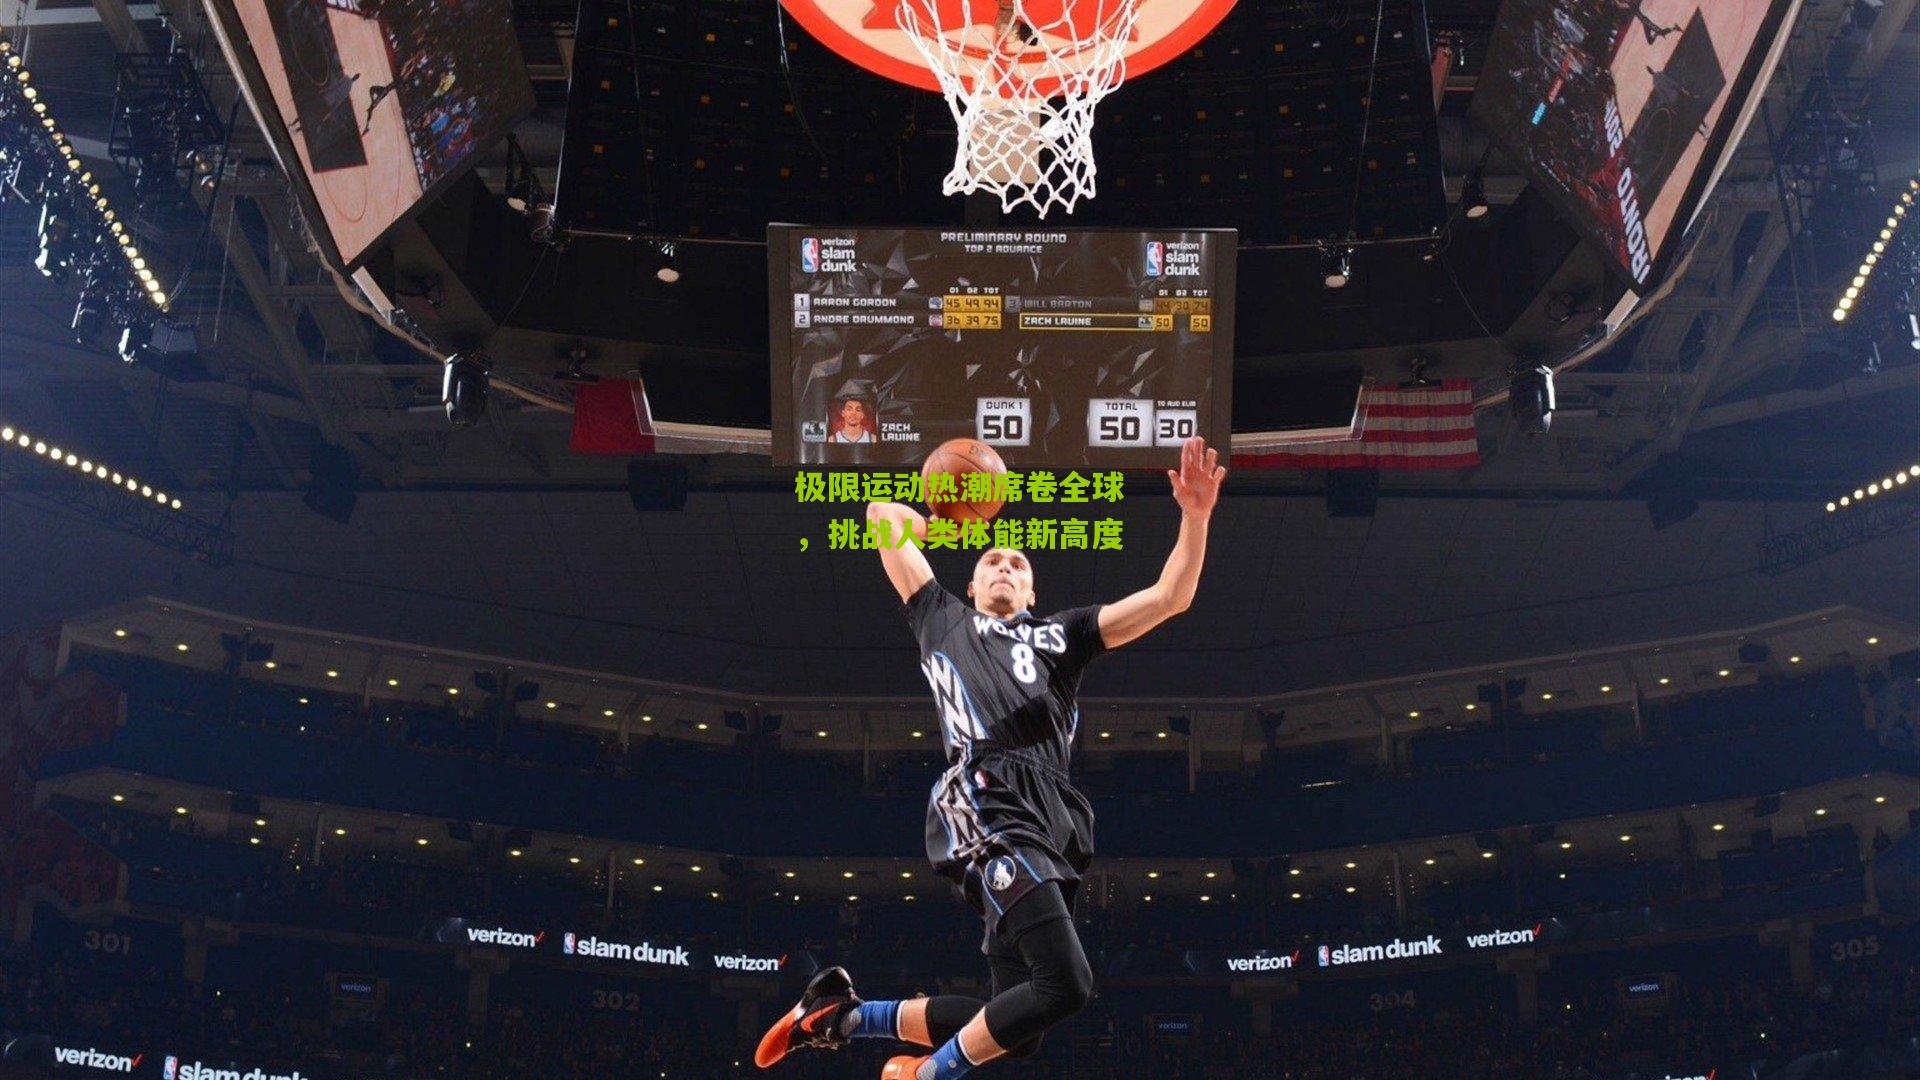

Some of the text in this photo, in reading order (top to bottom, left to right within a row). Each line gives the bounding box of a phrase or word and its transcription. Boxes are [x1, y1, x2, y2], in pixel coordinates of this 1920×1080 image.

[821, 238, 855, 246] verizon
[941, 232, 1067, 243] PRELIMINARY ROUND
[965, 245, 984, 253] TOP
[986, 245, 993, 253] 2
[1166, 241, 1199, 250] verizon
[821, 247, 855, 259] slam
[1166, 251, 1199, 263] slam
[821, 260, 857, 272] dunk
[1165, 263, 1200, 276] dunk
[813, 298, 850, 307] AARON
[853, 298, 896, 307] GORDON
[947, 299, 960, 307] 45
[966, 299, 979, 307] 49
[984, 299, 999, 308] 94
[1025, 300, 1047, 308] WILL
[814, 315, 850, 324] ANDRE
[852, 315, 914, 324] DRUMMOND
[966, 316, 979, 325] 39
[984, 316, 998, 325] 75
[1025, 317, 1052, 325] ZACH
[1157, 318, 1169, 327] 50
[1194, 319, 1208, 327] 50
[986, 401, 1015, 409] DUNK
[882, 424, 911, 432] ZACH
[983, 415, 1022, 439] 50
[1100, 416, 1140, 441] 50
[1160, 419, 1193, 438] 30
[882, 433, 920, 441] LAVINE
[973, 616, 1067, 653] WOLVES
[1011, 643, 1037, 684] 8
[467, 927, 536, 948] verizon
[1467, 927, 1535, 949] verizon
[577, 936, 690, 967] slam dunk
[1331, 935, 1441, 965] slam dunk
[714, 953, 779, 972] verizon
[1227, 953, 1292, 972] verizon
[1629, 982, 1659, 993] verizon
[55, 1047, 132, 1072] verizon
